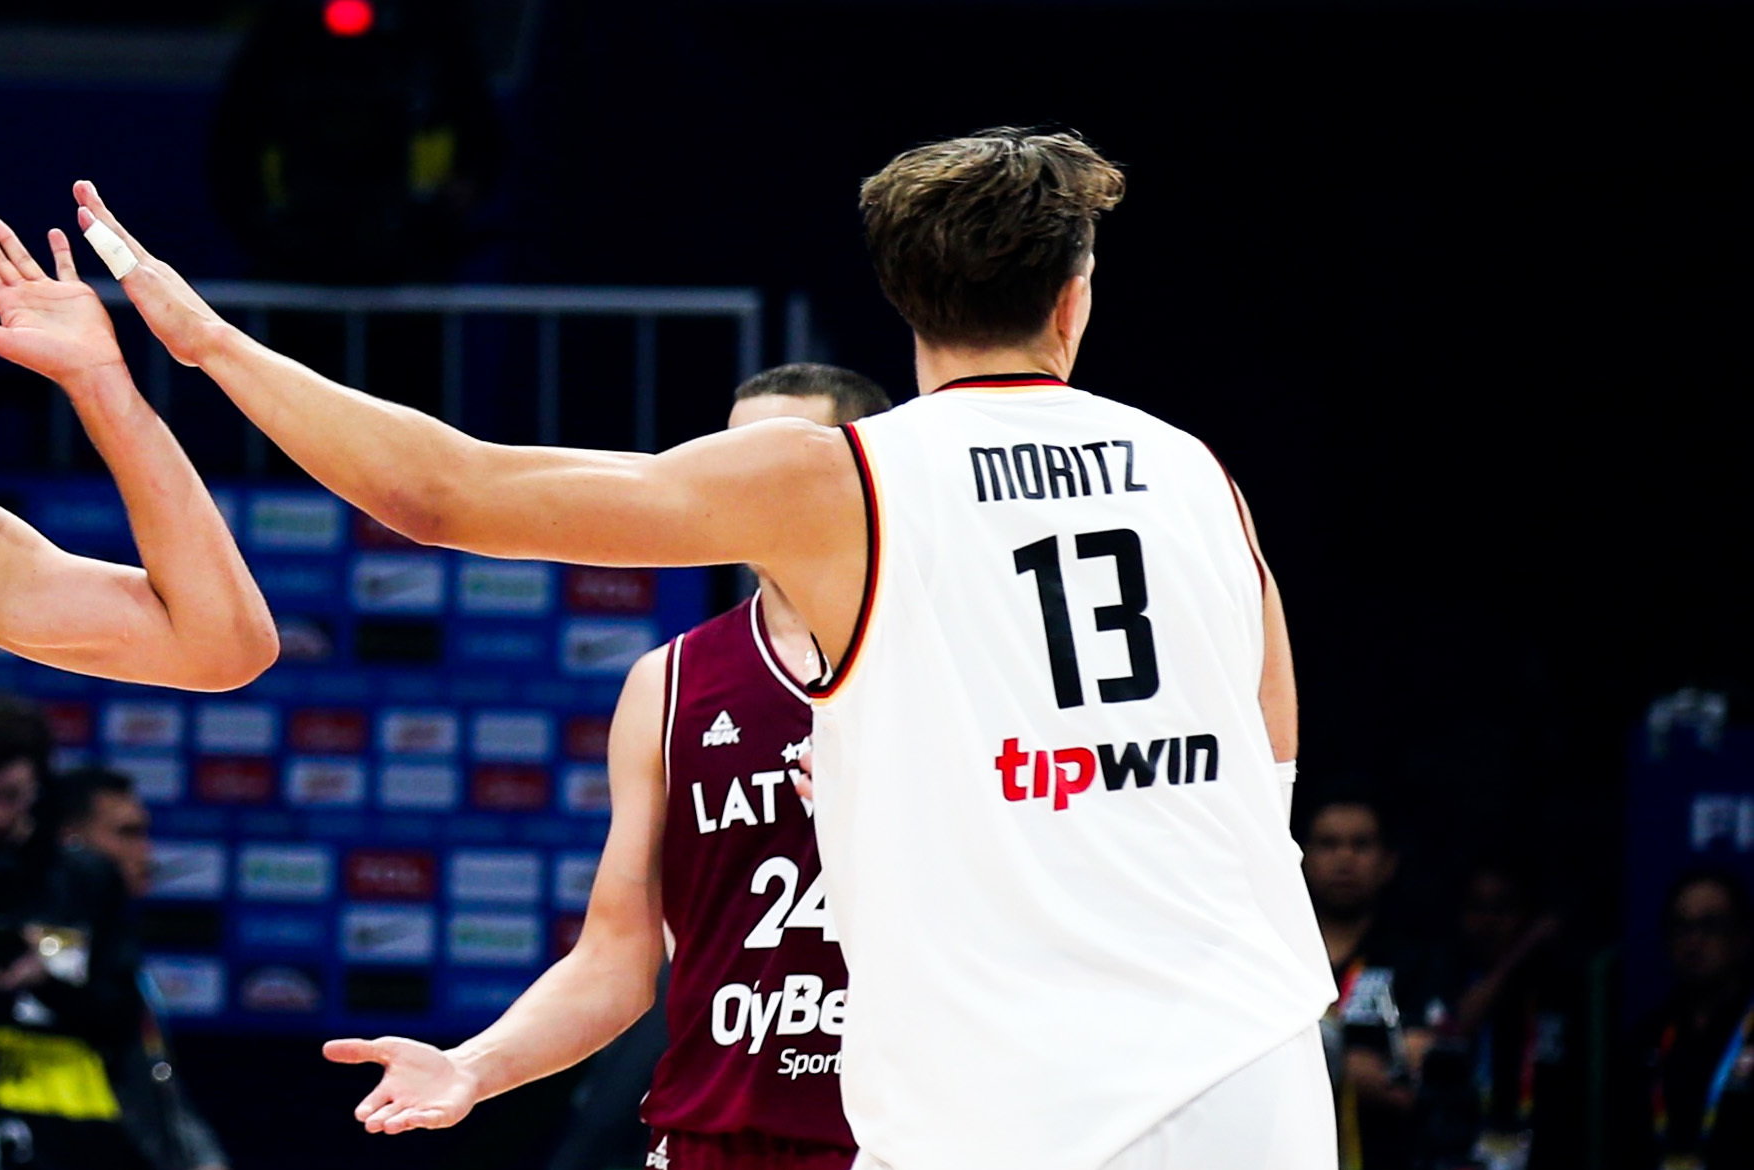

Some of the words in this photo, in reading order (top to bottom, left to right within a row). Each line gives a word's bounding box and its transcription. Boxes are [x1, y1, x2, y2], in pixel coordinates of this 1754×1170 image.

[969, 440, 1150, 502] MORITZ
[1012, 528, 1160, 710] 13
[702, 727, 742, 747] PEAK
[995, 733, 1220, 811] tipwin
[743, 856, 841, 949] 24
